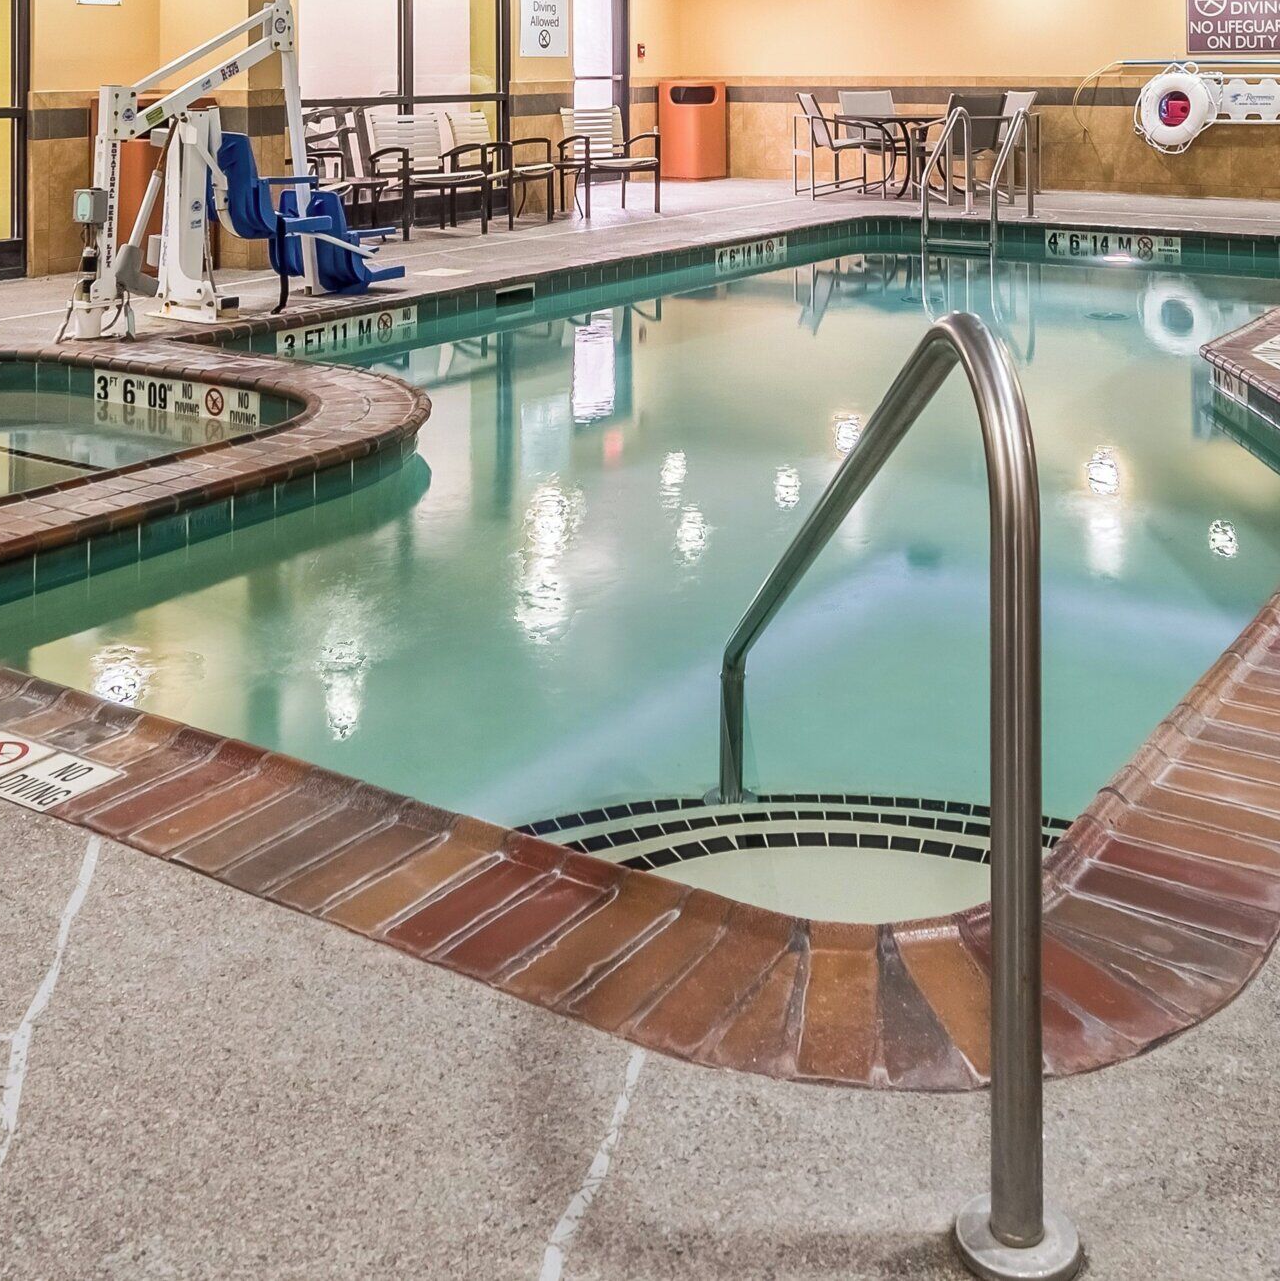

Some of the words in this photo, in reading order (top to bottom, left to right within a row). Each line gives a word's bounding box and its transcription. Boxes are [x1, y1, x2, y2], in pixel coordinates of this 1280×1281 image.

[533, 1, 557, 15] Diving
[530, 16, 560, 27] Allowed
[1190, 21, 1213, 34] NO
[1207, 35, 1231, 49] ON
[1235, 35, 1278, 49] DUTY
[108, 142, 117, 199] ROTATIONAL
[1048, 232, 1058, 245] 4
[1070, 234, 1080, 250] 6
[1118, 237, 1132, 251] M
[358, 318, 371, 335] M
[97, 376, 108, 400] 3
[109, 377, 118, 386] FT
[123, 379, 135, 404] 6
[137, 380, 145, 390] IN
[182, 383, 192, 399] NO
[238, 392, 249, 409] NO
[48, 761, 94, 782] NO
